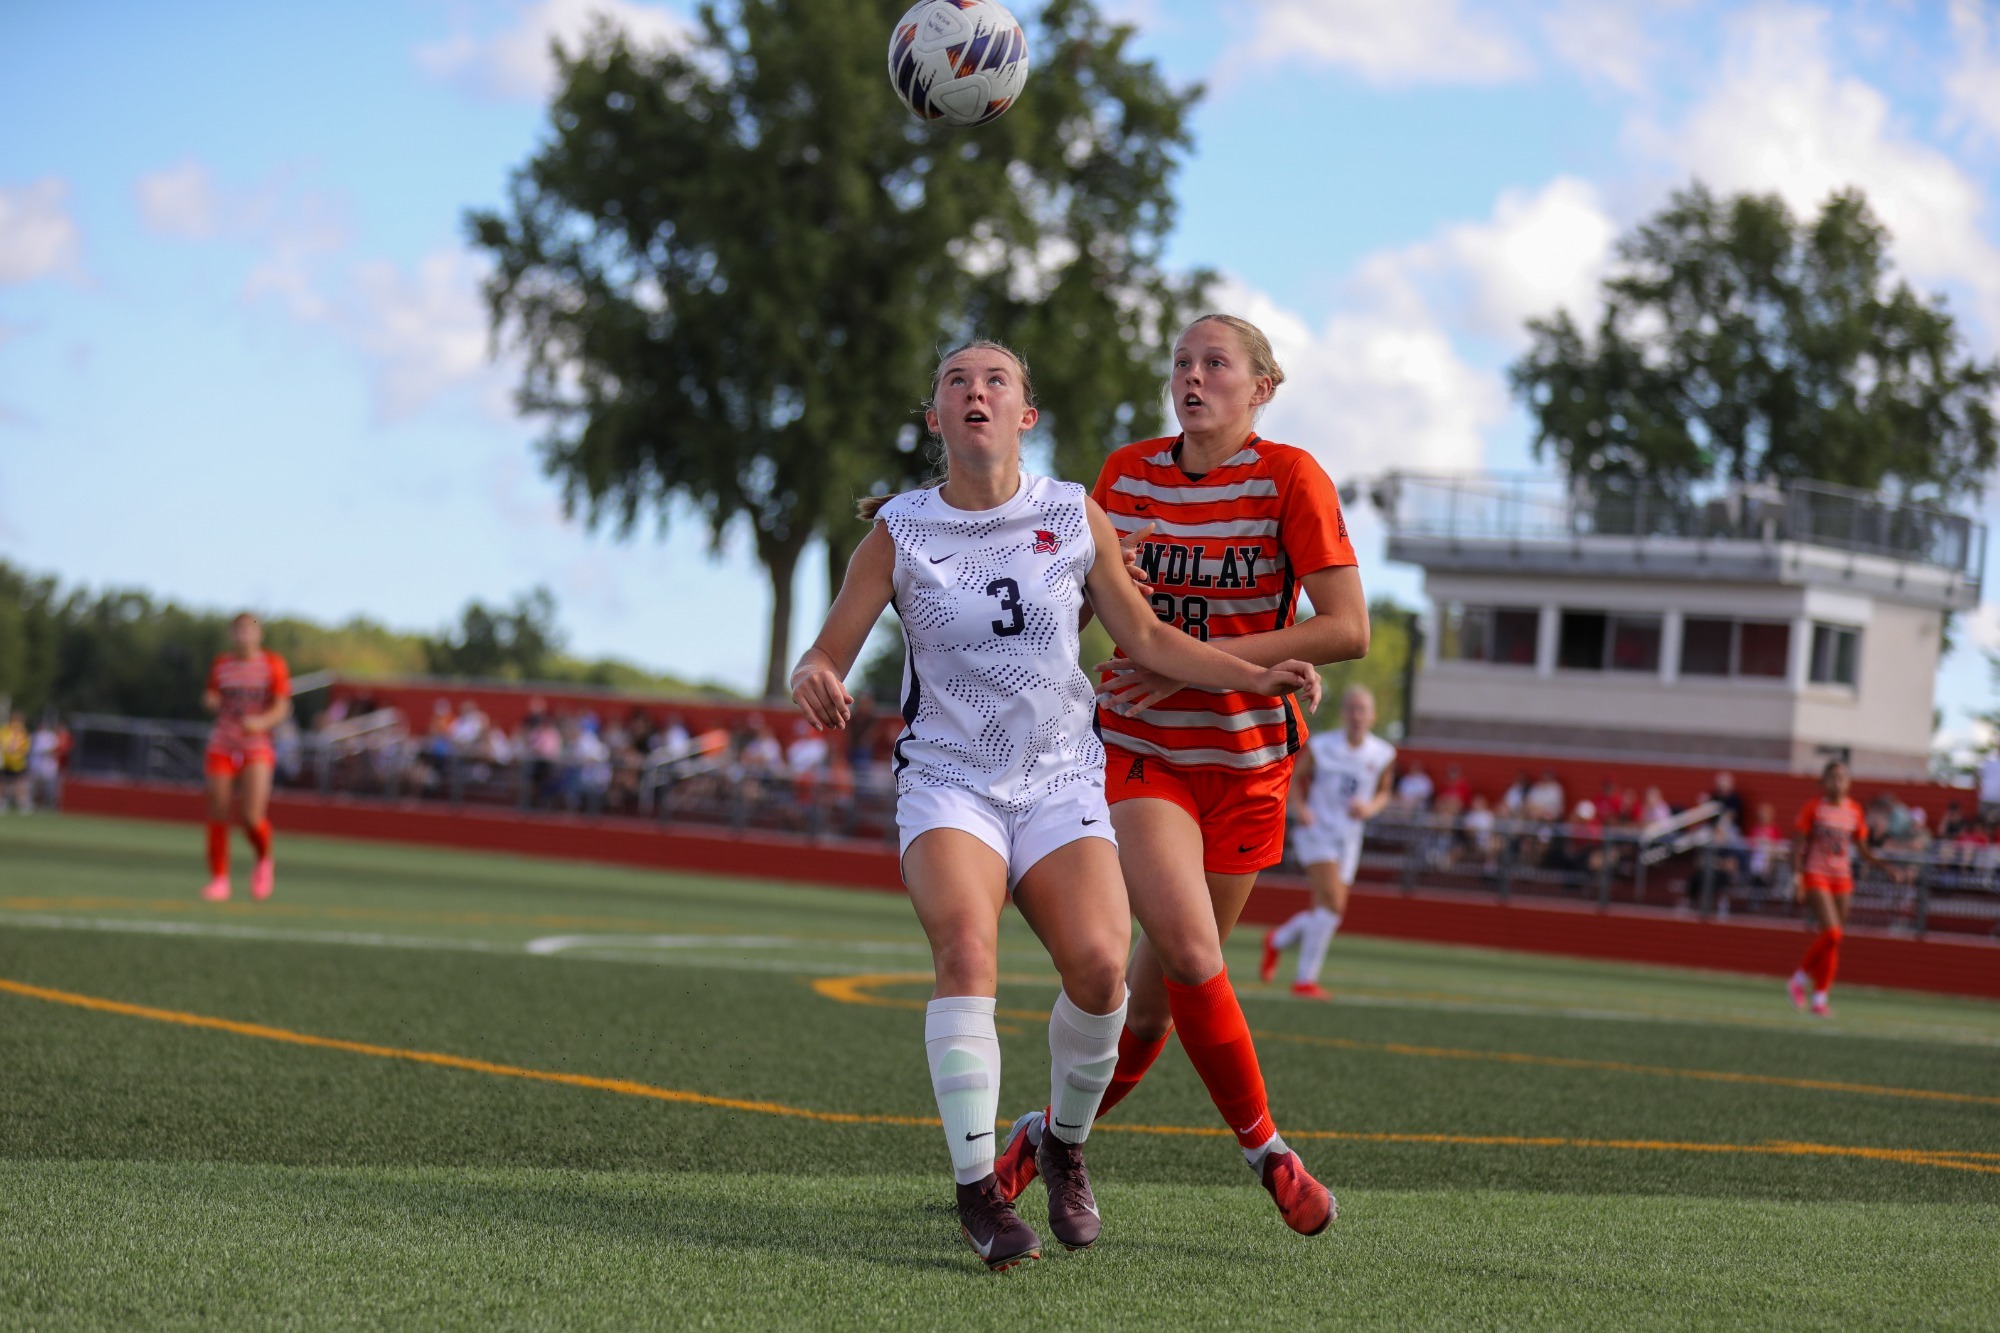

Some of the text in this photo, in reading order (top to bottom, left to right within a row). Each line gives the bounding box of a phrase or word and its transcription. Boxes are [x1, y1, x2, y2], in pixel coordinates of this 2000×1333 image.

[1032, 540, 1062, 555] SV
[1135, 541, 1262, 588] NDLAY
[986, 577, 1026, 638] 3
